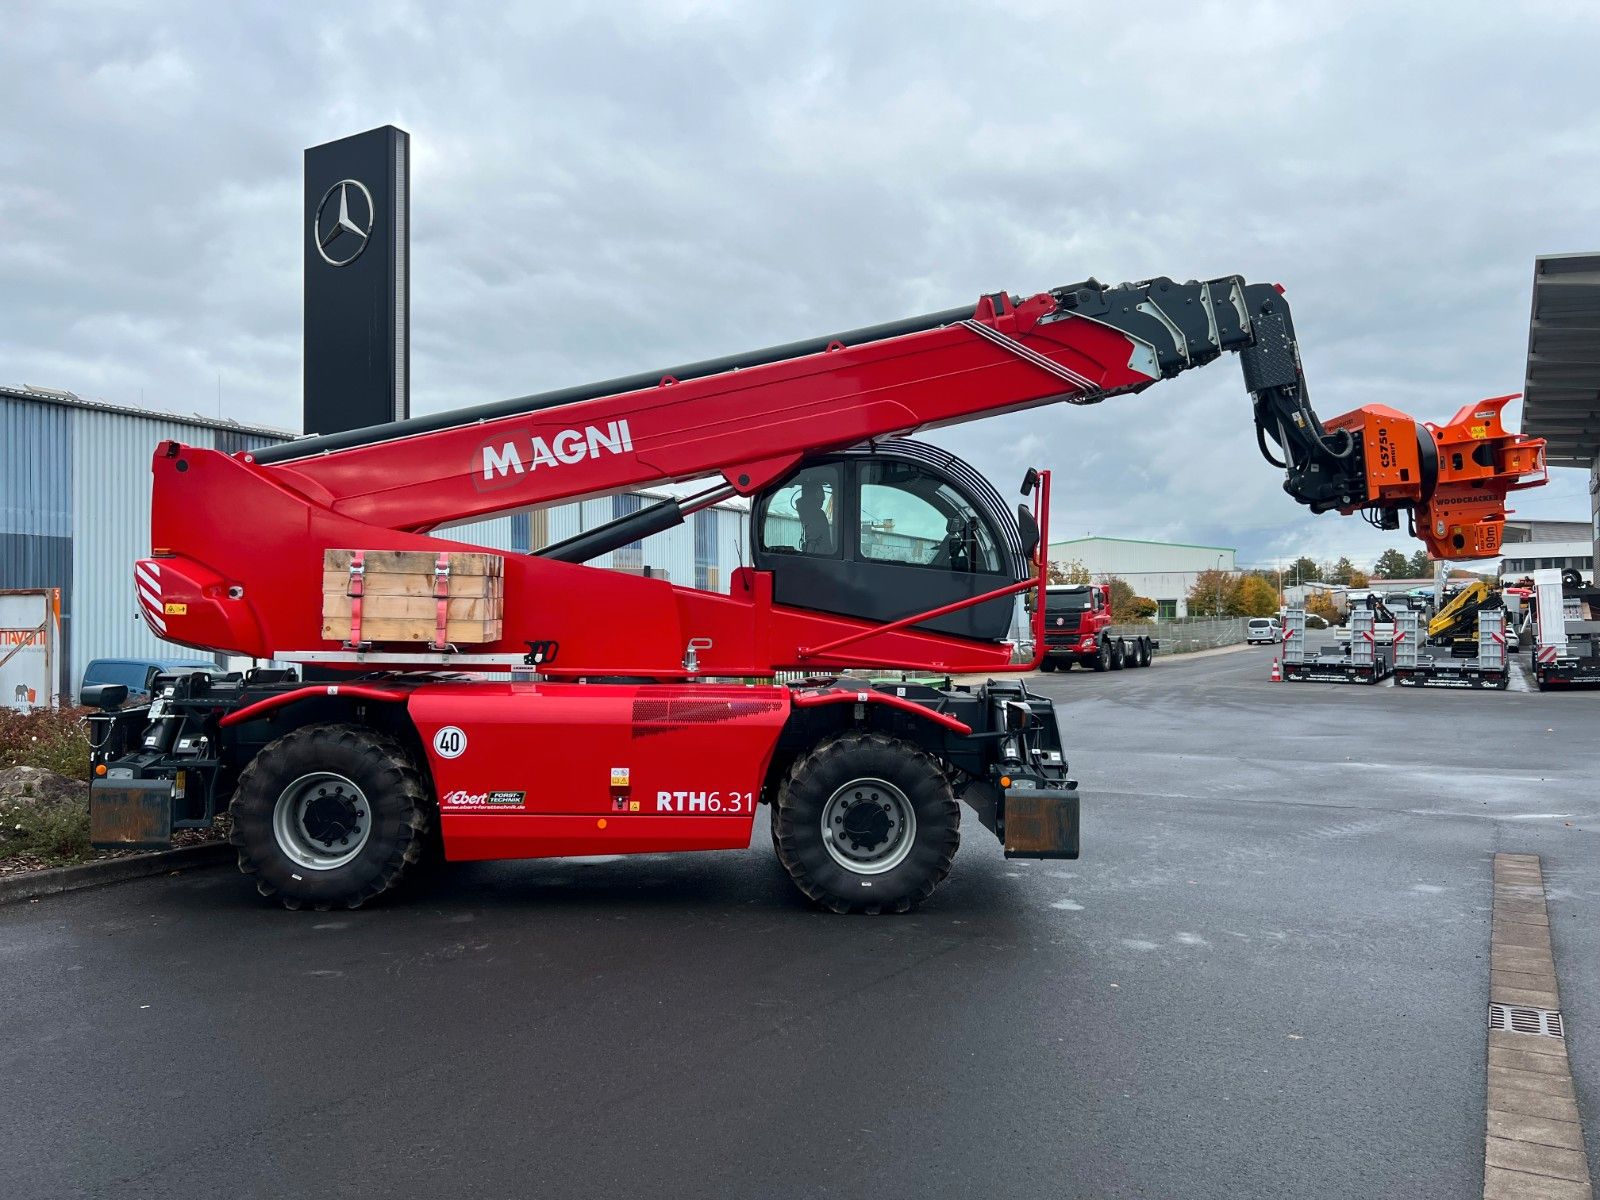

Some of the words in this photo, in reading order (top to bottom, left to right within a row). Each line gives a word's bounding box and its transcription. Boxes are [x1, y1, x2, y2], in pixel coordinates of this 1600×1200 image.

[483, 419, 633, 480] MAGNI
[1379, 428, 1389, 467] CS750
[1486, 526, 1496, 548] 90m
[440, 732, 460, 752] 40
[450, 791, 487, 804] Ebert
[656, 791, 752, 812] RTH6.31
